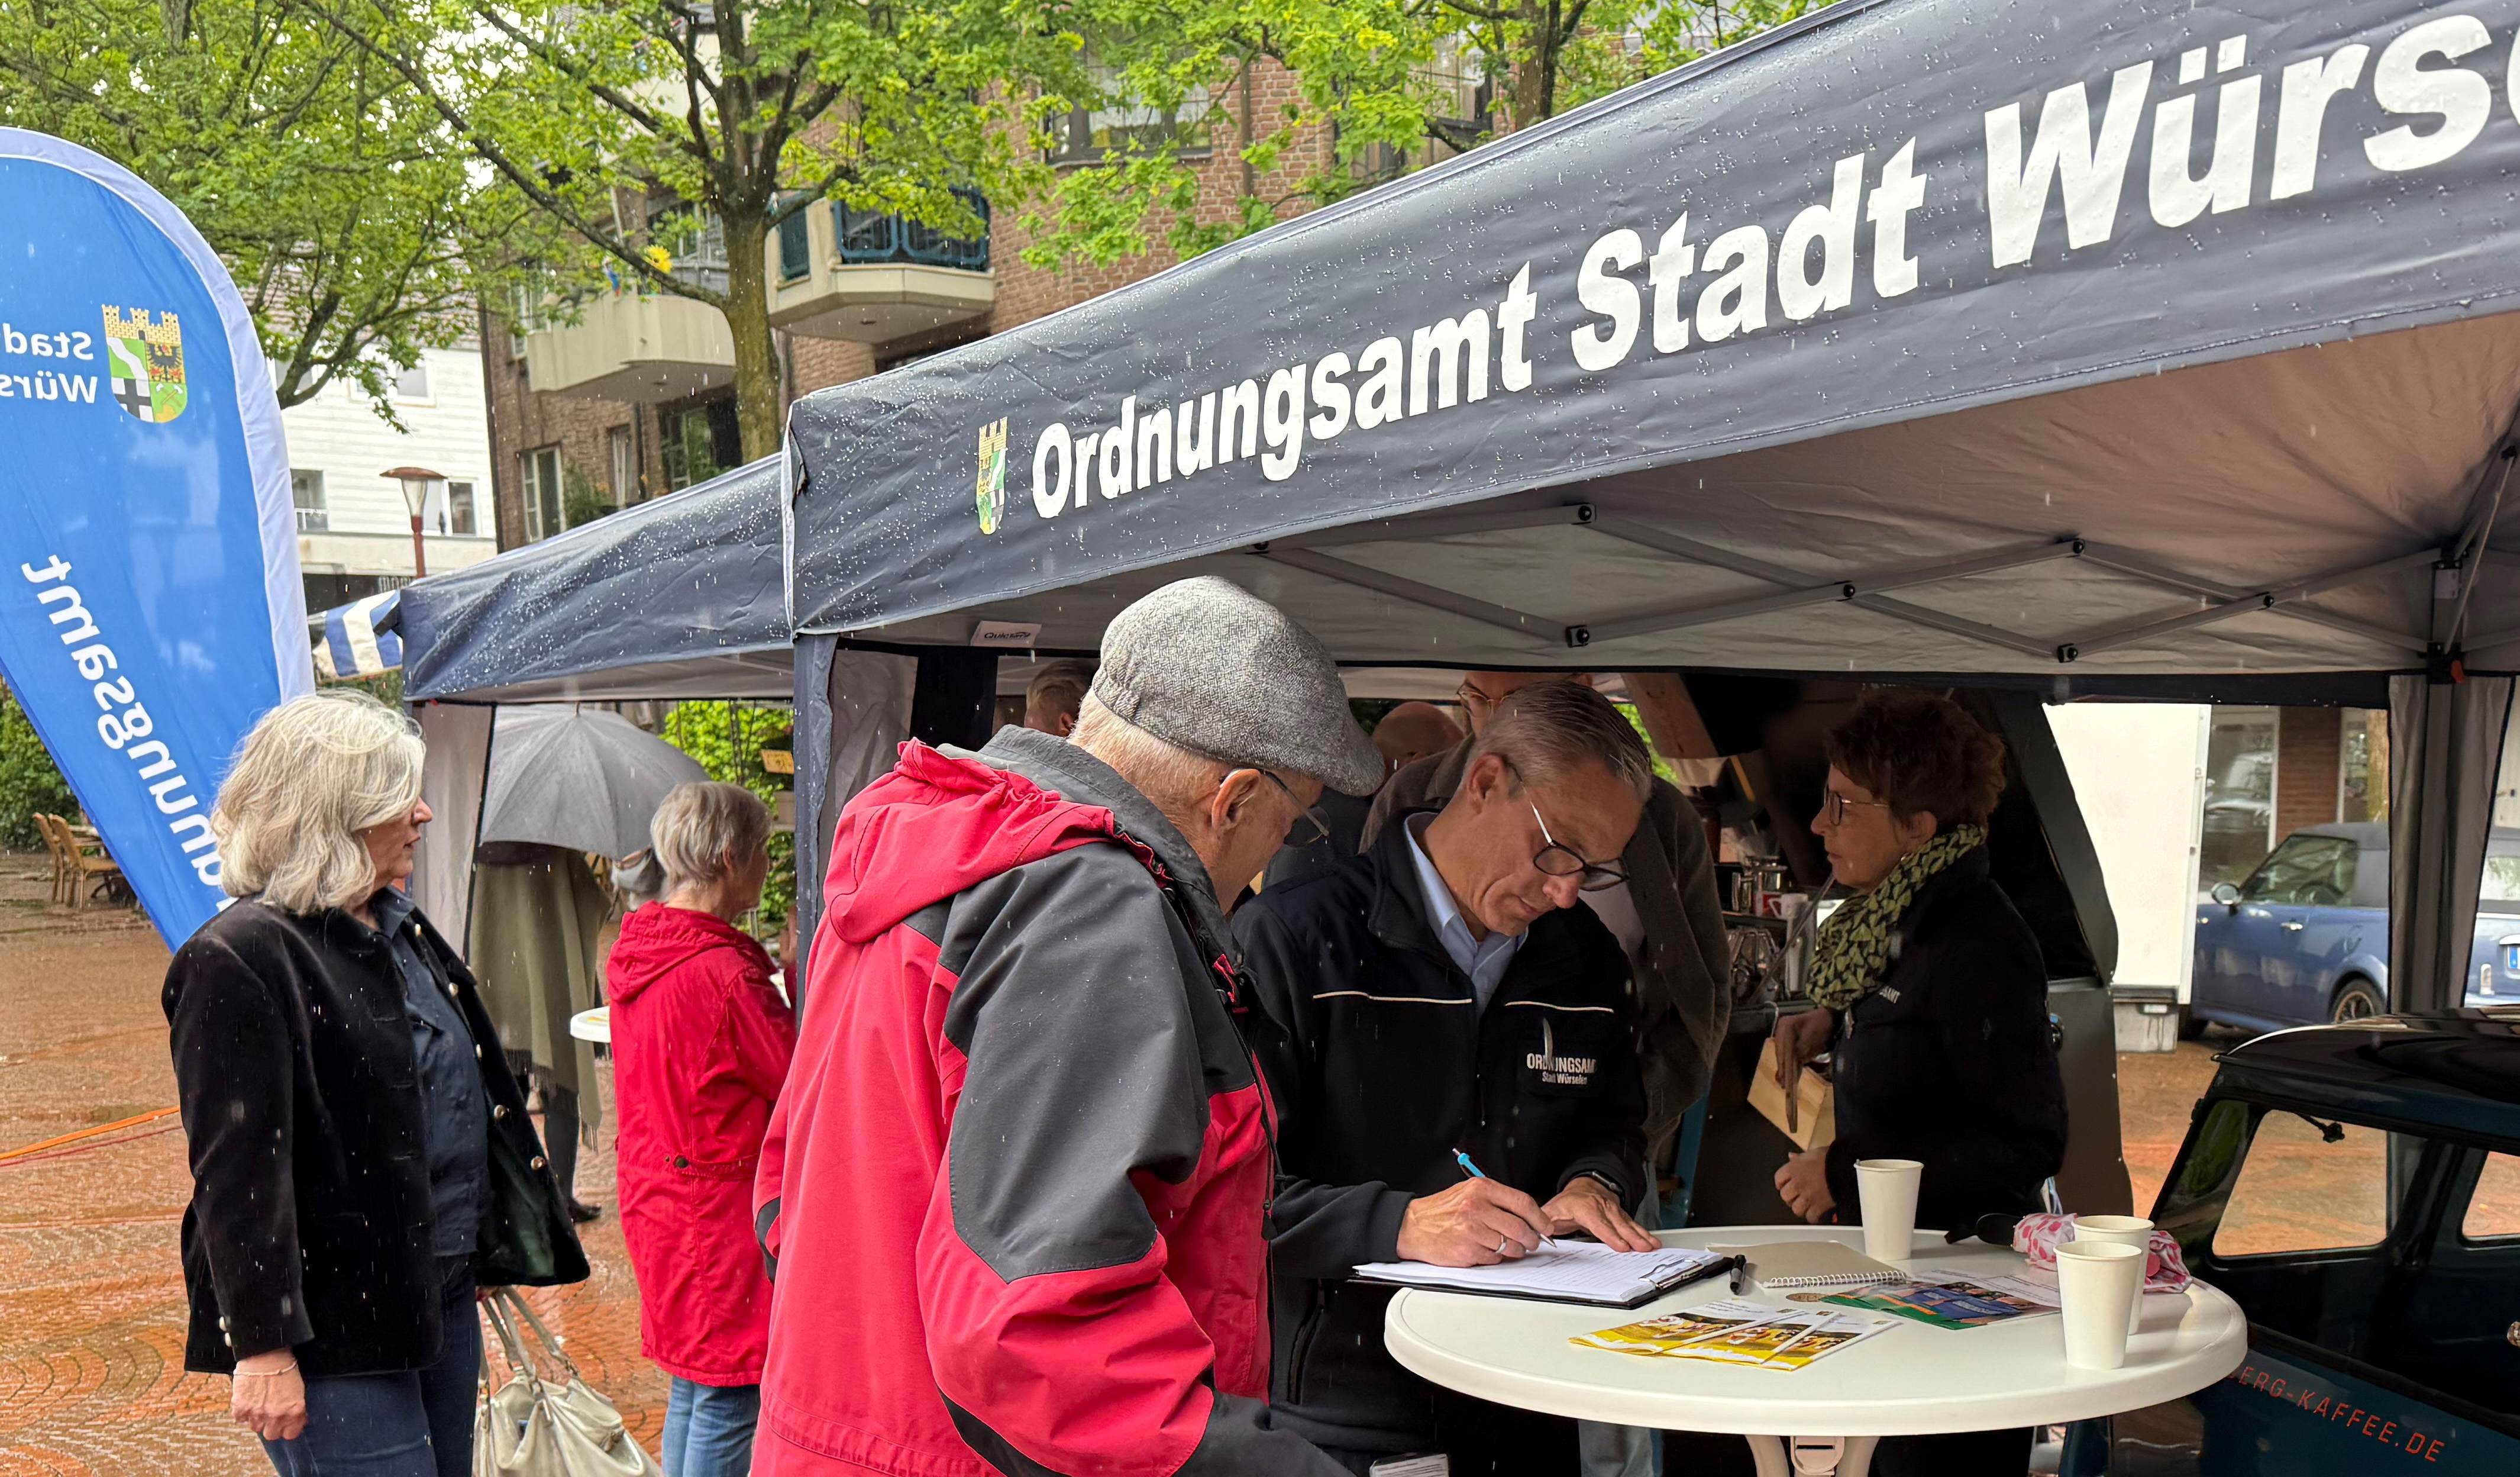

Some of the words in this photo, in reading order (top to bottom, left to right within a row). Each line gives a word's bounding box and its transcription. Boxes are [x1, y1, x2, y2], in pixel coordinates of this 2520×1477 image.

[1031, 260, 1537, 518] Ordnungsamt
[1571, 136, 1928, 372] Stadt
[1985, 14, 2520, 269] Würs
[2225, 1366, 2444, 1462] ERG-KAFFEE.DE
